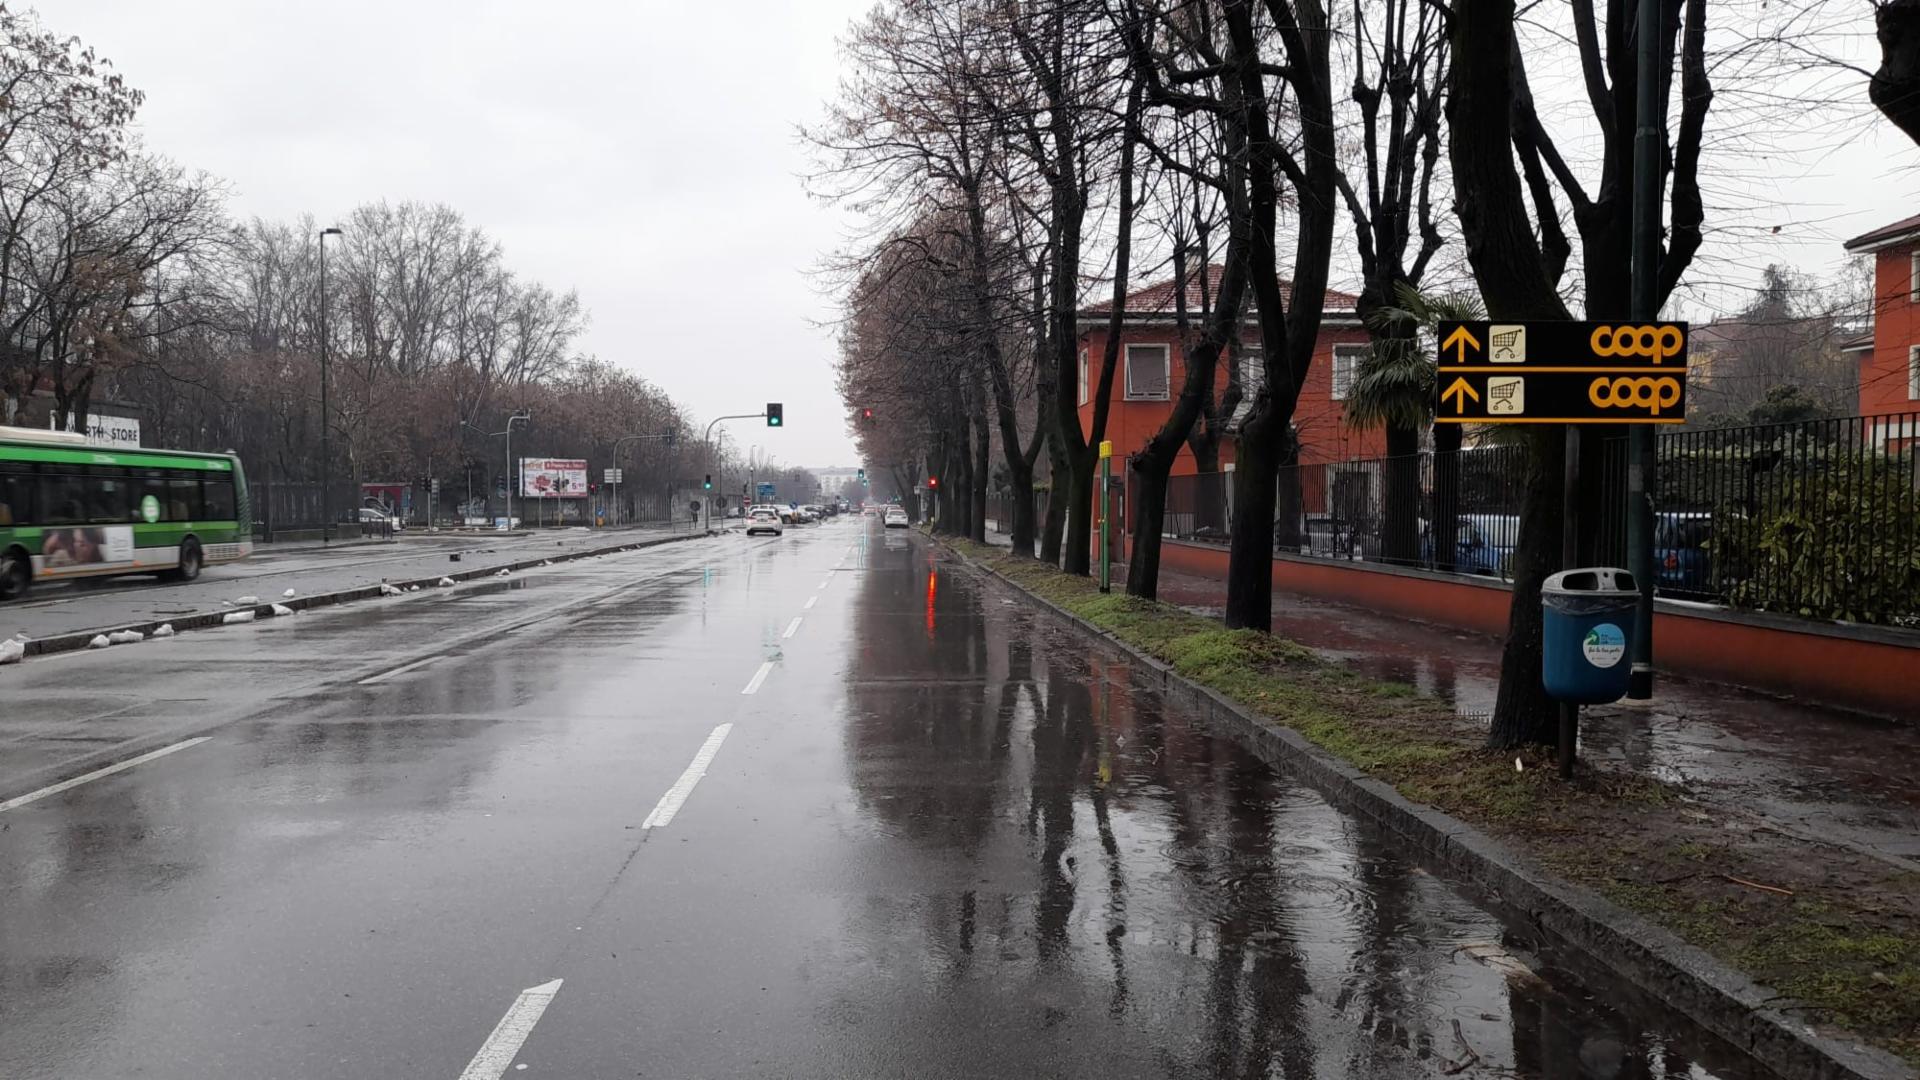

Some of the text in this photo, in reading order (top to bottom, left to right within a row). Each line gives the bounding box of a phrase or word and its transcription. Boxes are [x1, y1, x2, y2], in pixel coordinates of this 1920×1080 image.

[1590, 325, 1684, 364] coop
[1588, 376, 1681, 416] coop
[111, 427, 138, 442] STORE
